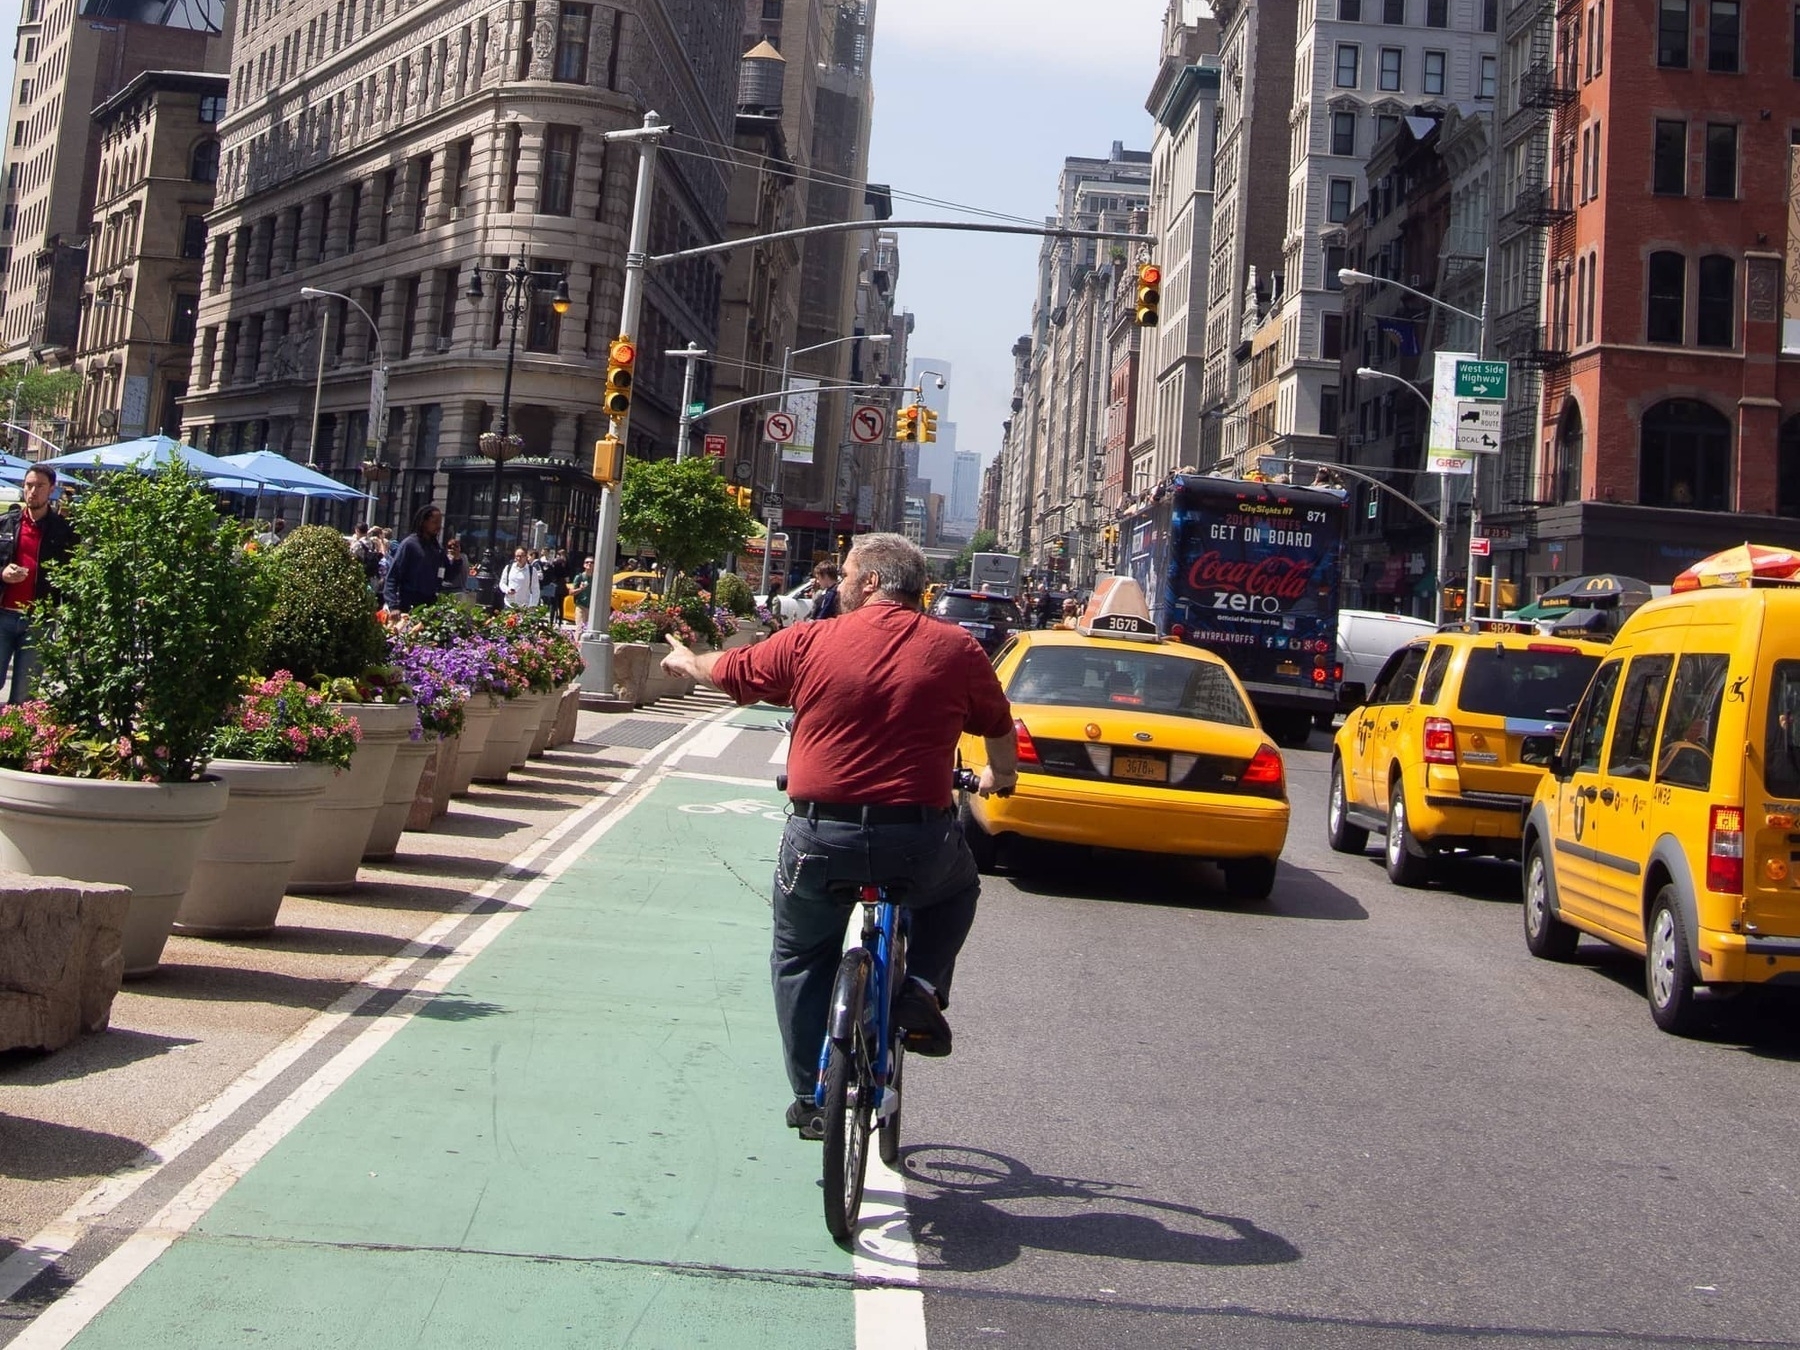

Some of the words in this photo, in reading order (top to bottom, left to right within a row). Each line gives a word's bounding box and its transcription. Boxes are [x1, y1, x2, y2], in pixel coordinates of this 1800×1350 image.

[1460, 364, 1481, 373] West
[1485, 365, 1504, 374] Side
[1461, 373, 1501, 385] Highway
[1481, 409, 1499, 417] TRUCK
[1457, 436, 1480, 444] LOCAL
[1435, 458, 1466, 468] GREY
[1307, 511, 1326, 523] 871
[1210, 524, 1237, 541] GET
[1244, 527, 1260, 543] ON
[1268, 529, 1313, 548] BOARD
[1109, 617, 1138, 631] 3G78
[1490, 623, 1517, 634] 9B24
